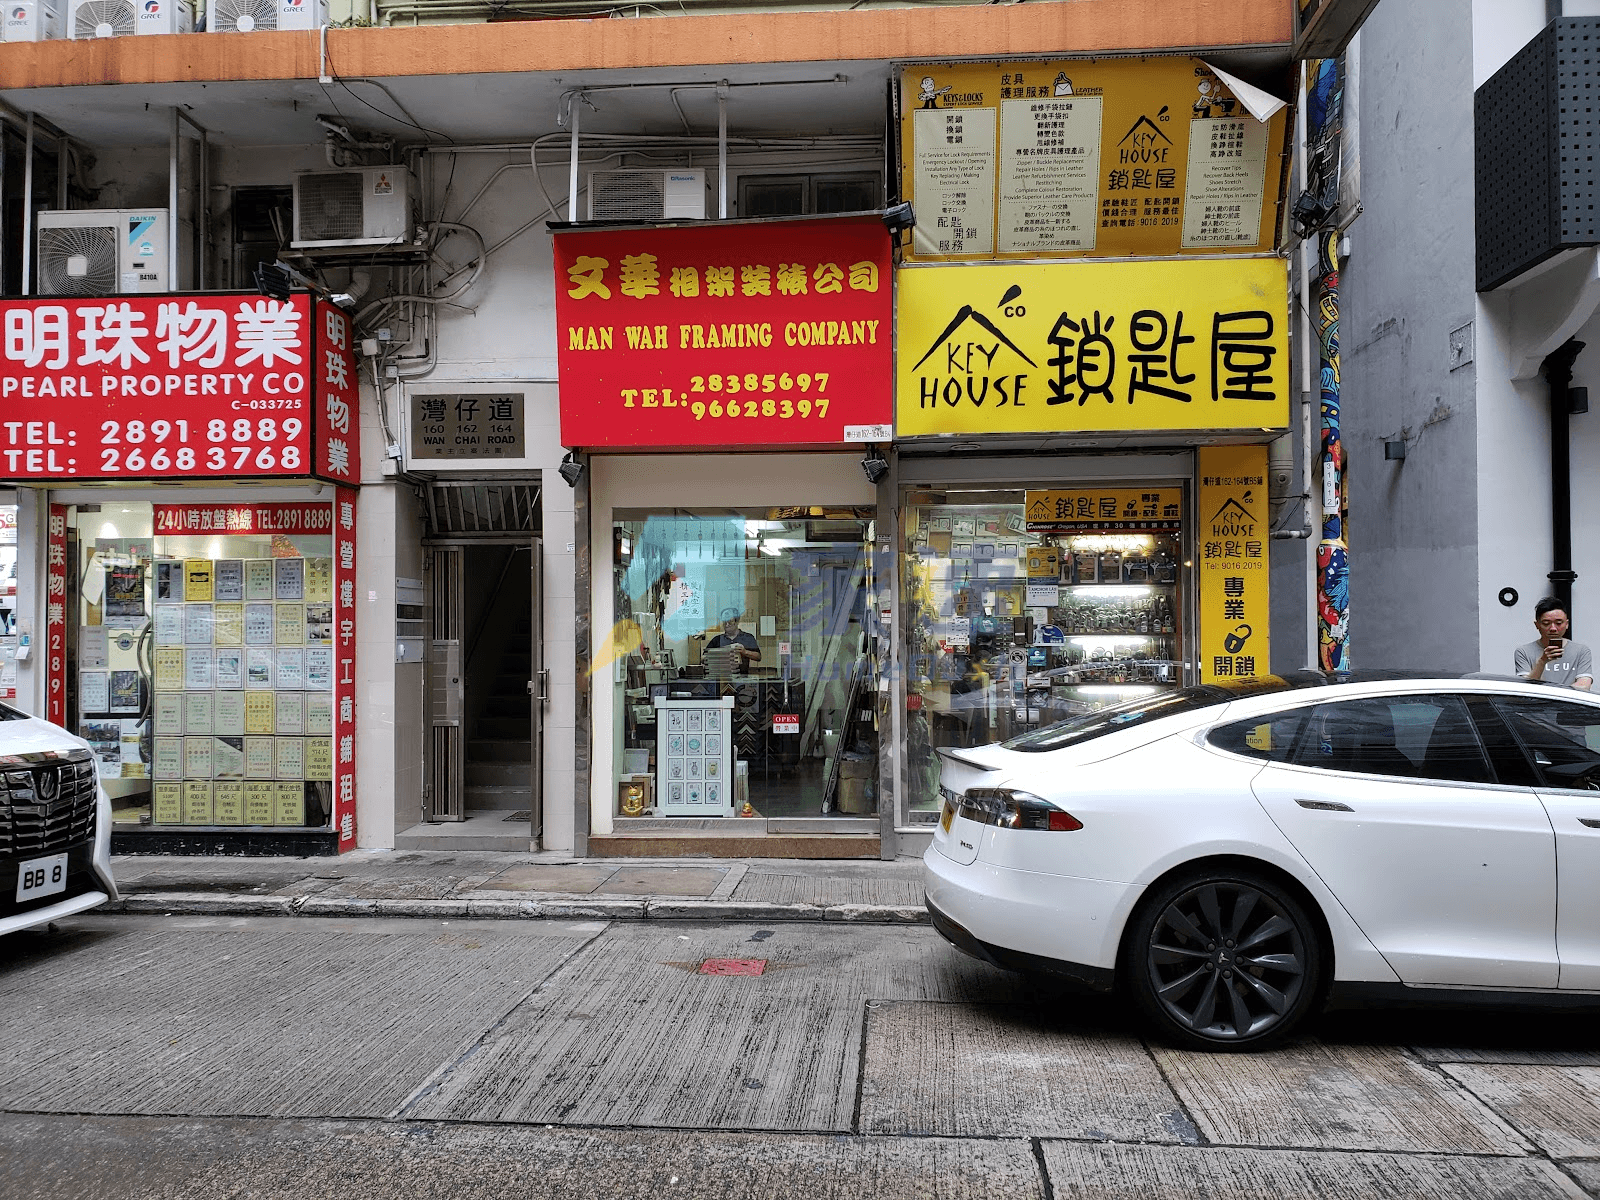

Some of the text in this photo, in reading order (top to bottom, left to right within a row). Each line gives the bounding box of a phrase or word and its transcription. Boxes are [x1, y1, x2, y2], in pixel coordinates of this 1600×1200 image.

[1001, 73, 1024, 85] 皮具
[1001, 86, 1049, 98] 護理服務
[946, 126, 962, 134] 換鎖
[1133, 133, 1157, 148] KEY
[1120, 148, 1168, 164] HOUSE
[1108, 168, 1175, 190] 鎖匙屋
[1144, 197, 1180, 206] 配匙開鎖
[1102, 208, 1137, 217] 價錢合理
[1161, 217, 1179, 226] 2019
[937, 216, 962, 228] 配匙
[953, 228, 977, 239] 開鎖
[939, 240, 963, 251] 服務
[567, 252, 879, 300] 文華相架裝裱公司
[1004, 306, 1026, 318] CO
[5, 300, 302, 370] 明珠物業
[568, 320, 879, 350] MAN WAH FRAMING COMPANY
[947, 342, 1000, 374] KEY
[1047, 310, 1276, 406] 鎖匙屋
[2, 372, 304, 397] PEARL PROPERTY CO
[690, 373, 830, 393] 28385697
[920, 374, 1028, 408] HOUSE
[325, 310, 350, 477] 明珠物業
[231, 400, 302, 410] C-033725
[421, 398, 514, 422] 灣仔道
[620, 388, 830, 420] TEL: 96628397
[3, 418, 302, 446] TEL: 2891 8889
[423, 424, 512, 434] 160 162 164
[423, 435, 516, 445] WAN CHAI ROAD
[4, 446, 300, 474] TEL: 2668 3768
[1055, 497, 1117, 519] 鎖匙屋
[157, 509, 252, 531] 24小時放盤熱線
[304, 509, 331, 529] 8889
[1223, 511, 1244, 524] KEY
[1212, 524, 1254, 537] HOUSE
[1204, 541, 1263, 558] 鎖匙屋
[1205, 562, 1219, 570] Tel:
[1222, 562, 1241, 570] 9016
[1224, 577, 1245, 619] 專業
[1214, 656, 1255, 676] 開鎖
[23, 865, 61, 890] BB 8
